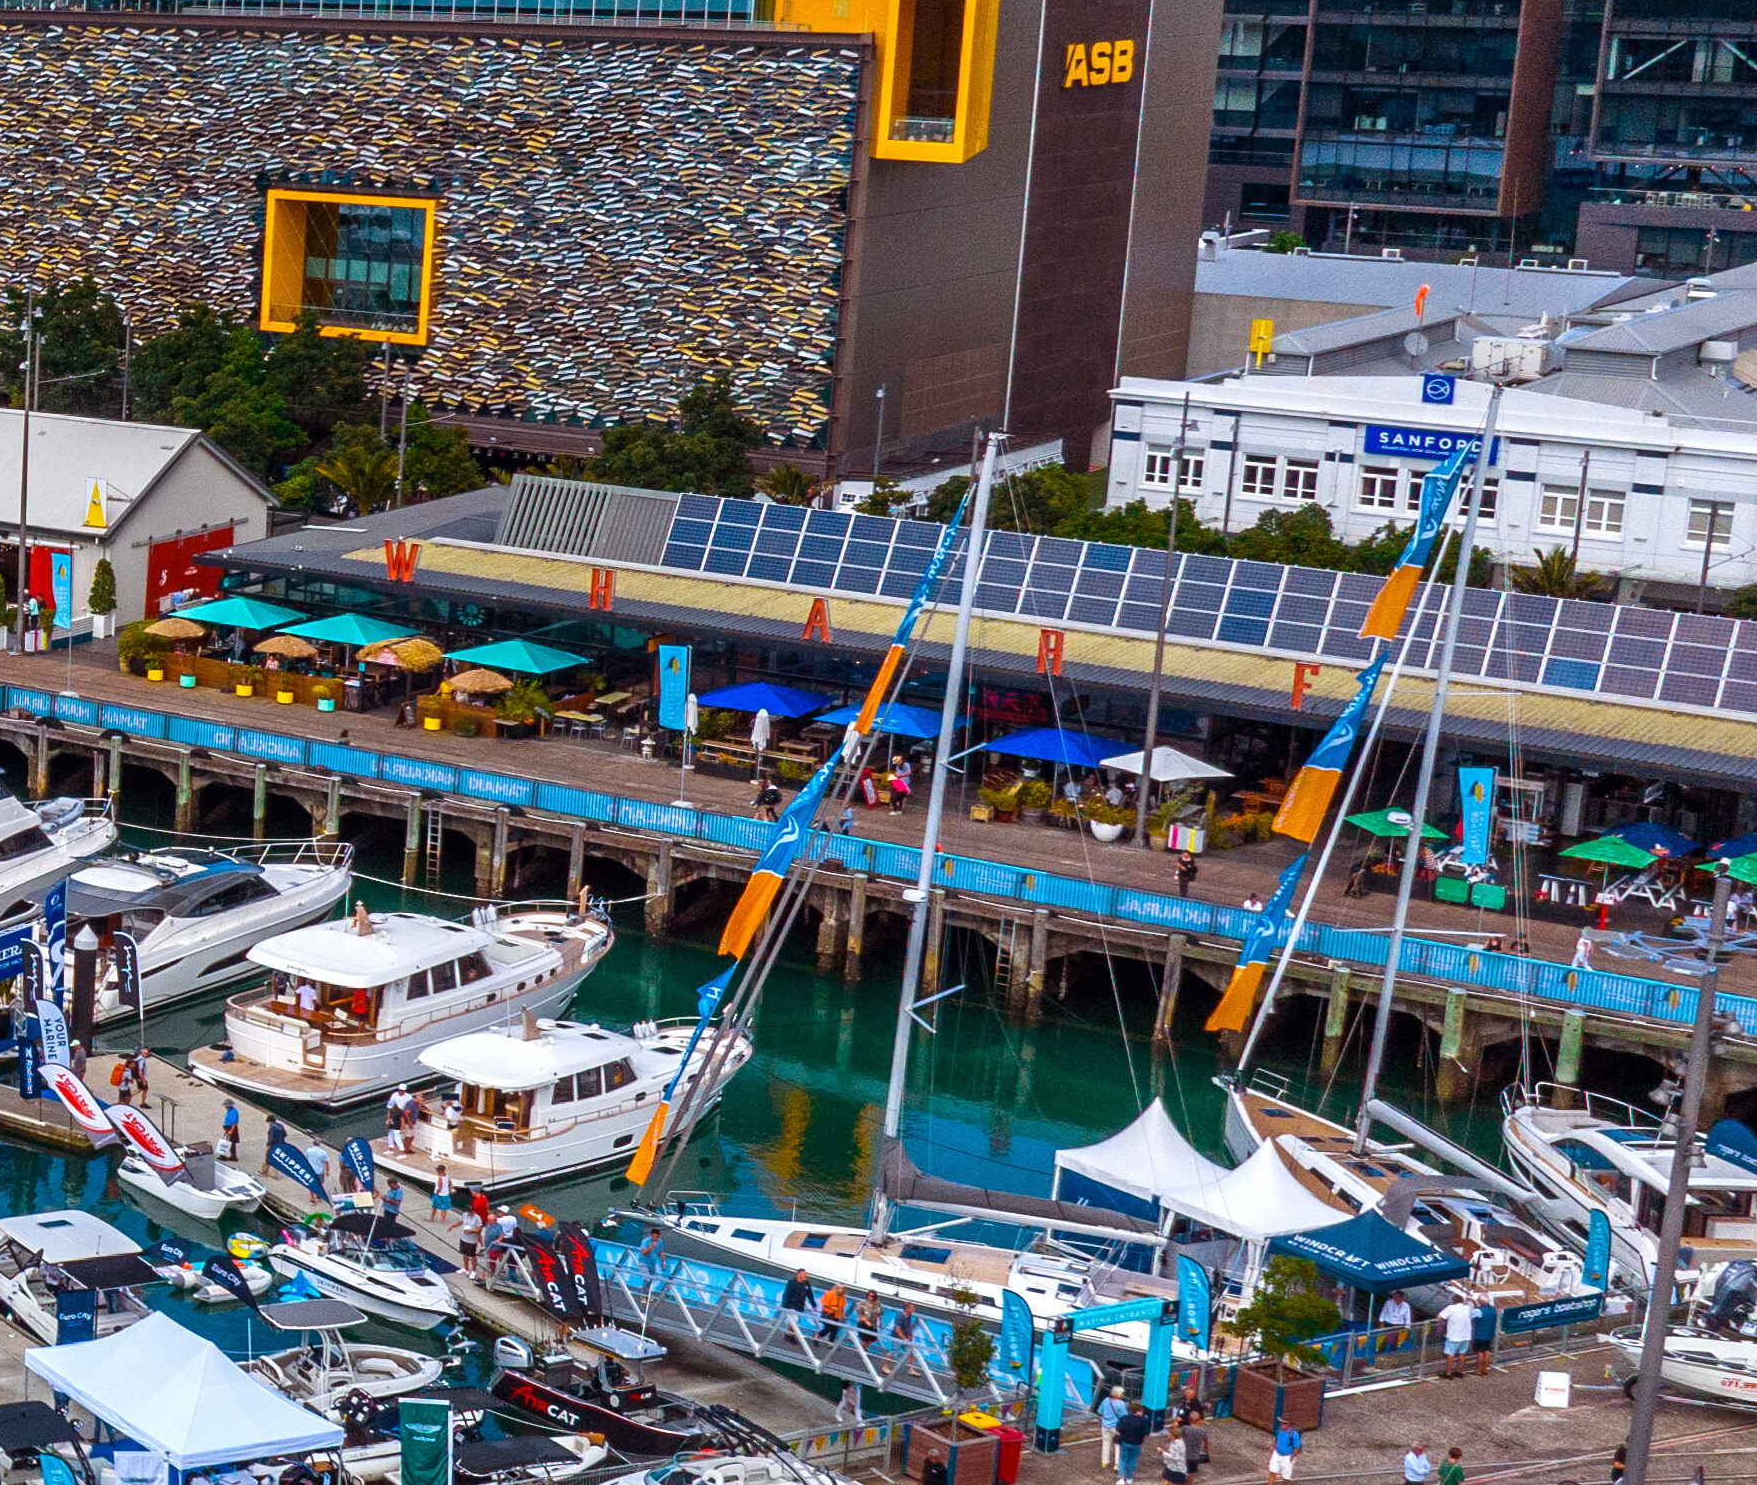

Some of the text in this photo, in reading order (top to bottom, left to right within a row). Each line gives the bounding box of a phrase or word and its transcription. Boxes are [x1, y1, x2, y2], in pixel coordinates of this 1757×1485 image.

[1064, 39, 1134, 88] ASB
[44, 1018, 58, 1061] MARINE
[56, 1016, 66, 1048] YOUR
[211, 1262, 242, 1286] Euro City
[59, 1311, 93, 1321] Euro City
[1517, 1304, 1551, 1322] rogers
[511, 1384, 581, 1427] AIRCAT
